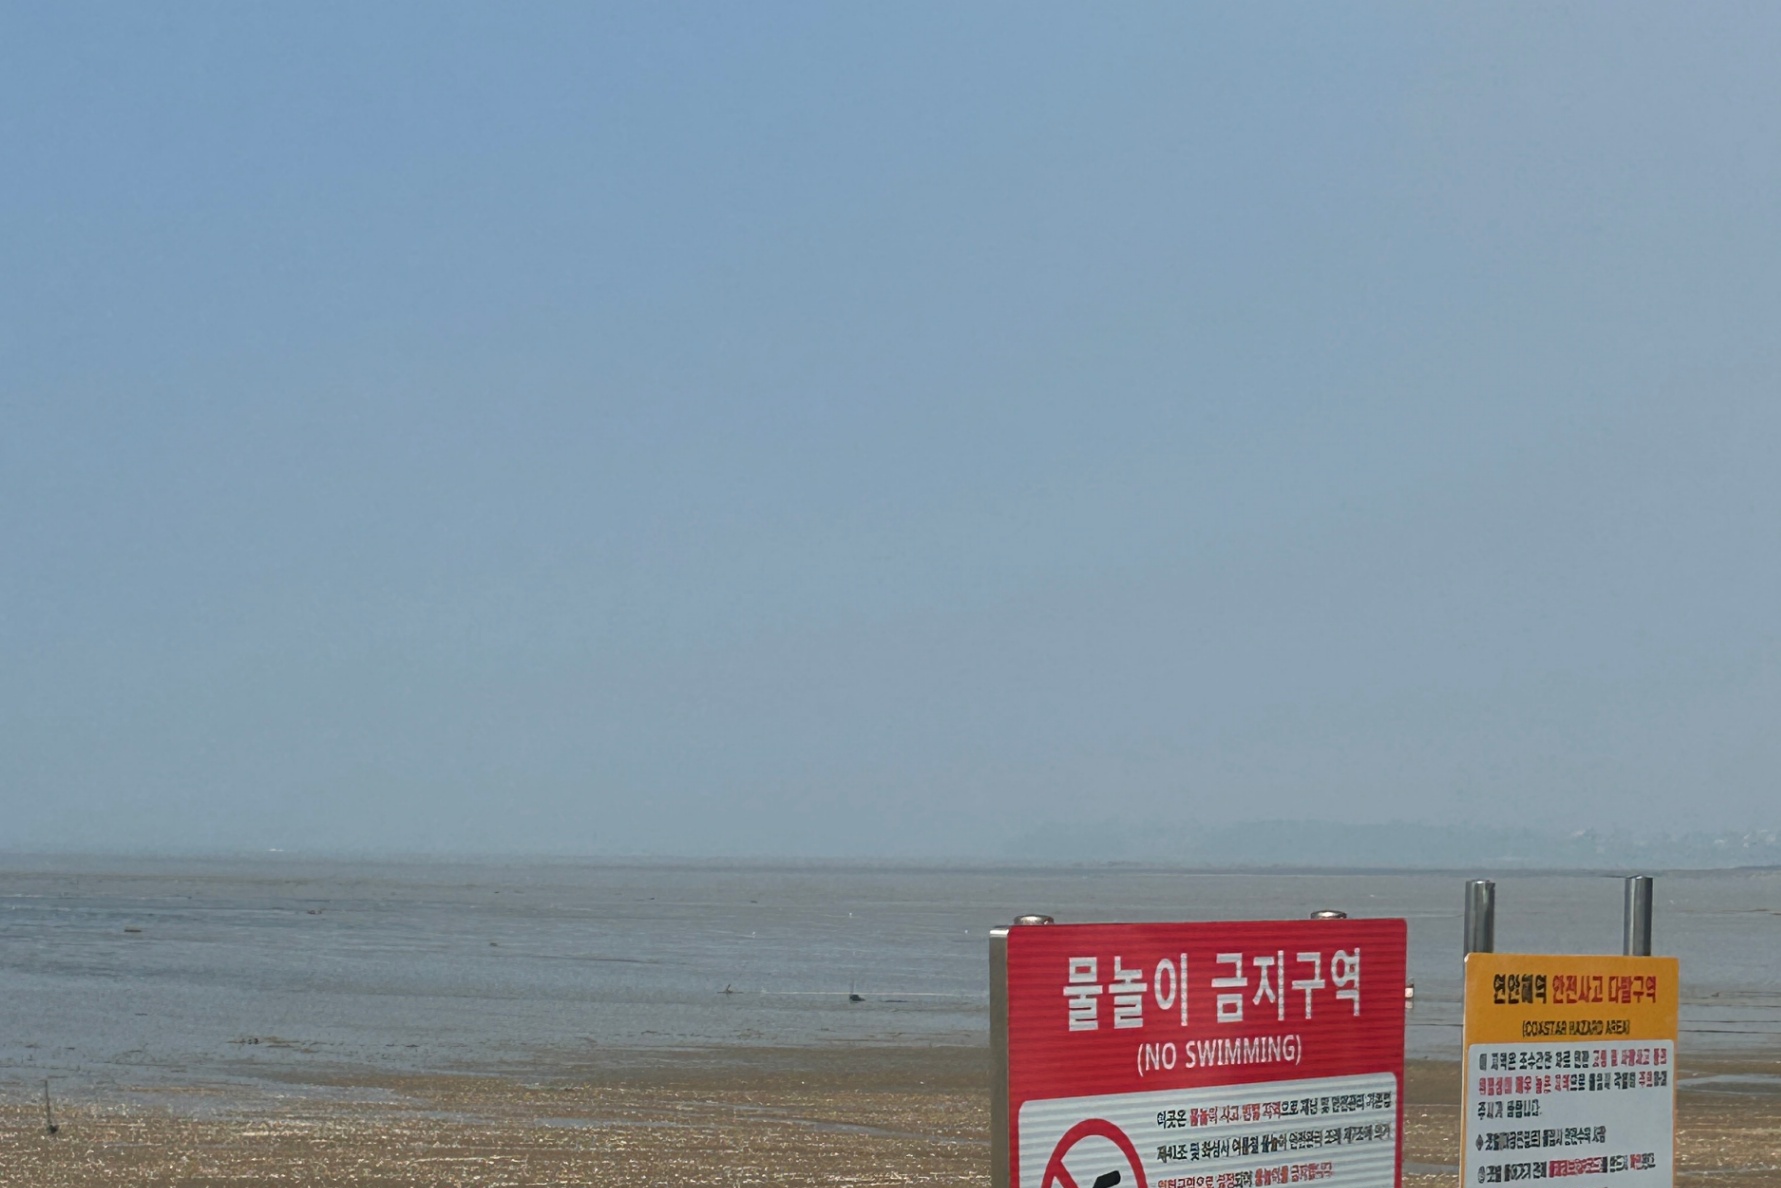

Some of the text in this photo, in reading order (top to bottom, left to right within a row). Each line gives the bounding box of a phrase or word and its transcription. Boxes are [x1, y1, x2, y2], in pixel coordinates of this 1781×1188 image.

[1062, 947, 1361, 1032] 물놀이 금지구역
[1493, 973, 1657, 1004] 연안해역 안전사고 다발구역
[1137, 1034, 1302, 1077] (NO SWIMMING)
